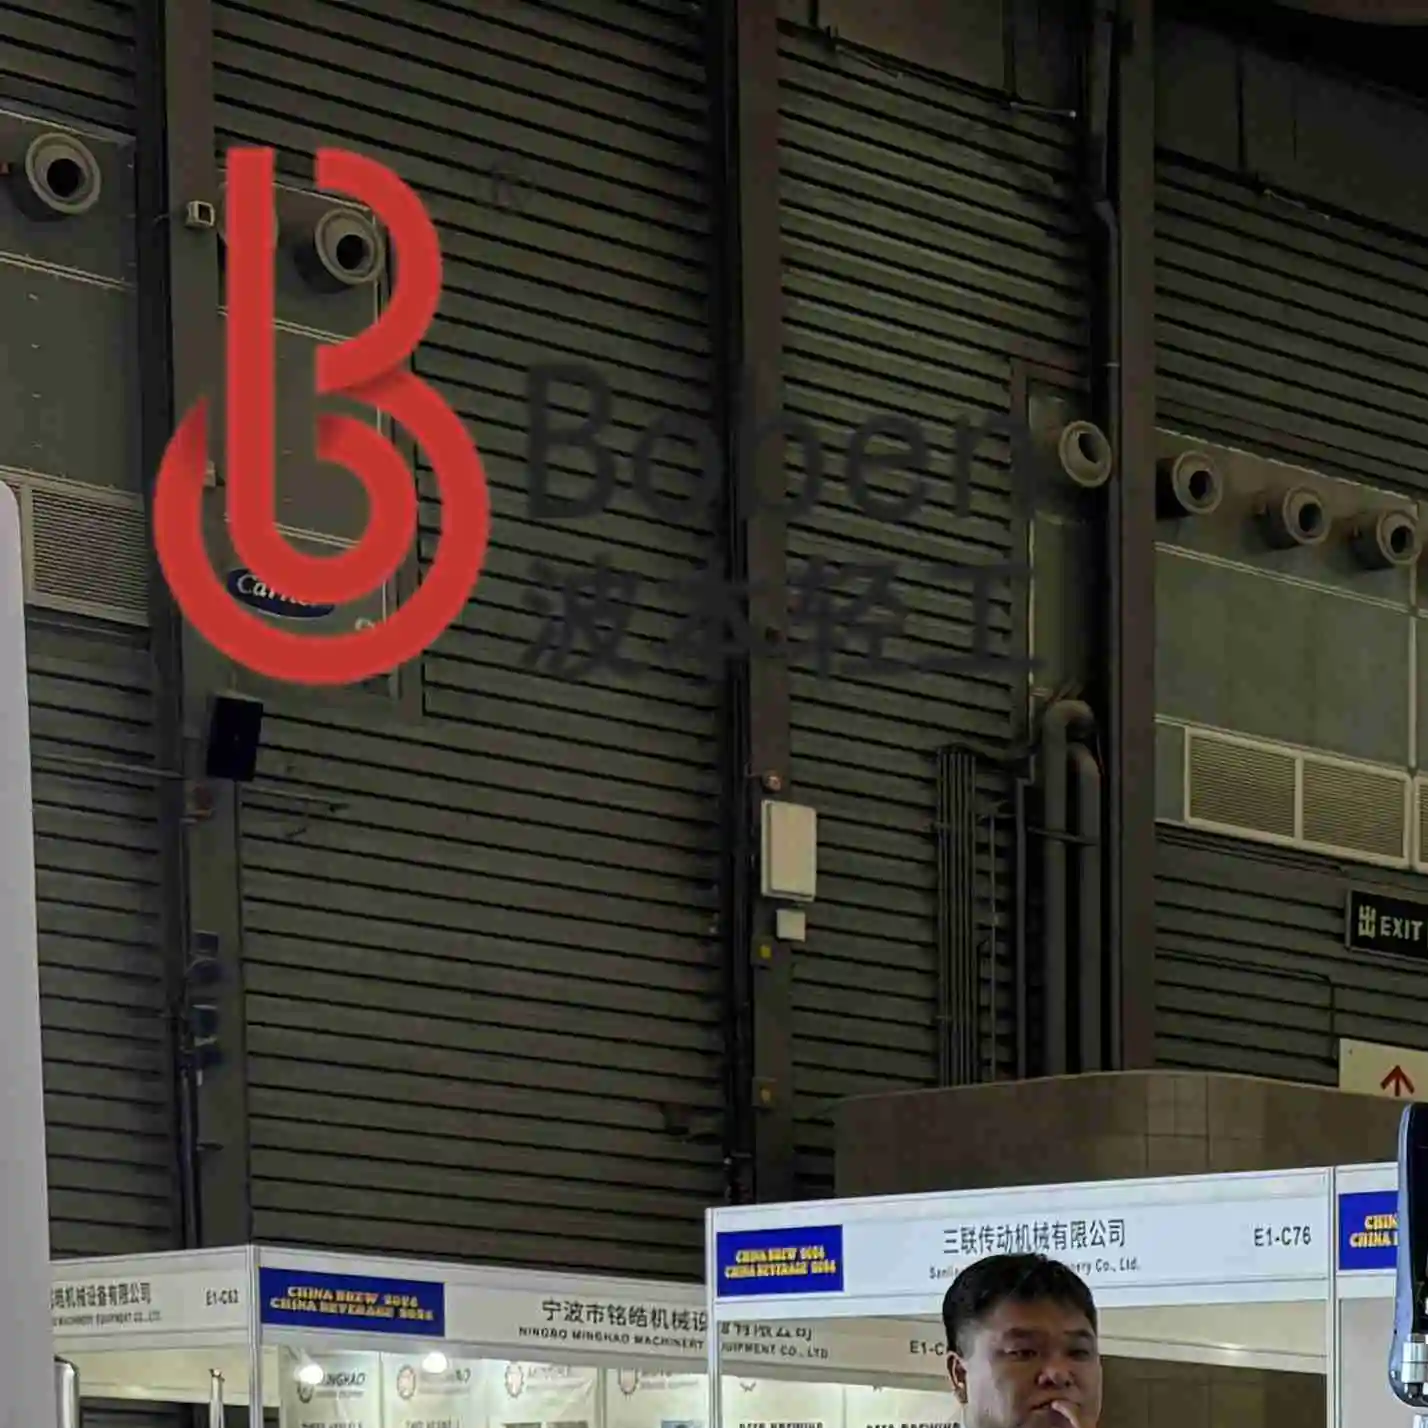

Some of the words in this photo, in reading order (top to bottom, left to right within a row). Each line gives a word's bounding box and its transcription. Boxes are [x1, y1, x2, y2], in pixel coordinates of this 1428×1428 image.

[1380, 916, 1424, 941] EXIT
[943, 1219, 1127, 1255] 三联传动机械有限公司
[1253, 1225, 1313, 1247] E1-C76
[572, 1331, 630, 1344] MINGHAO
